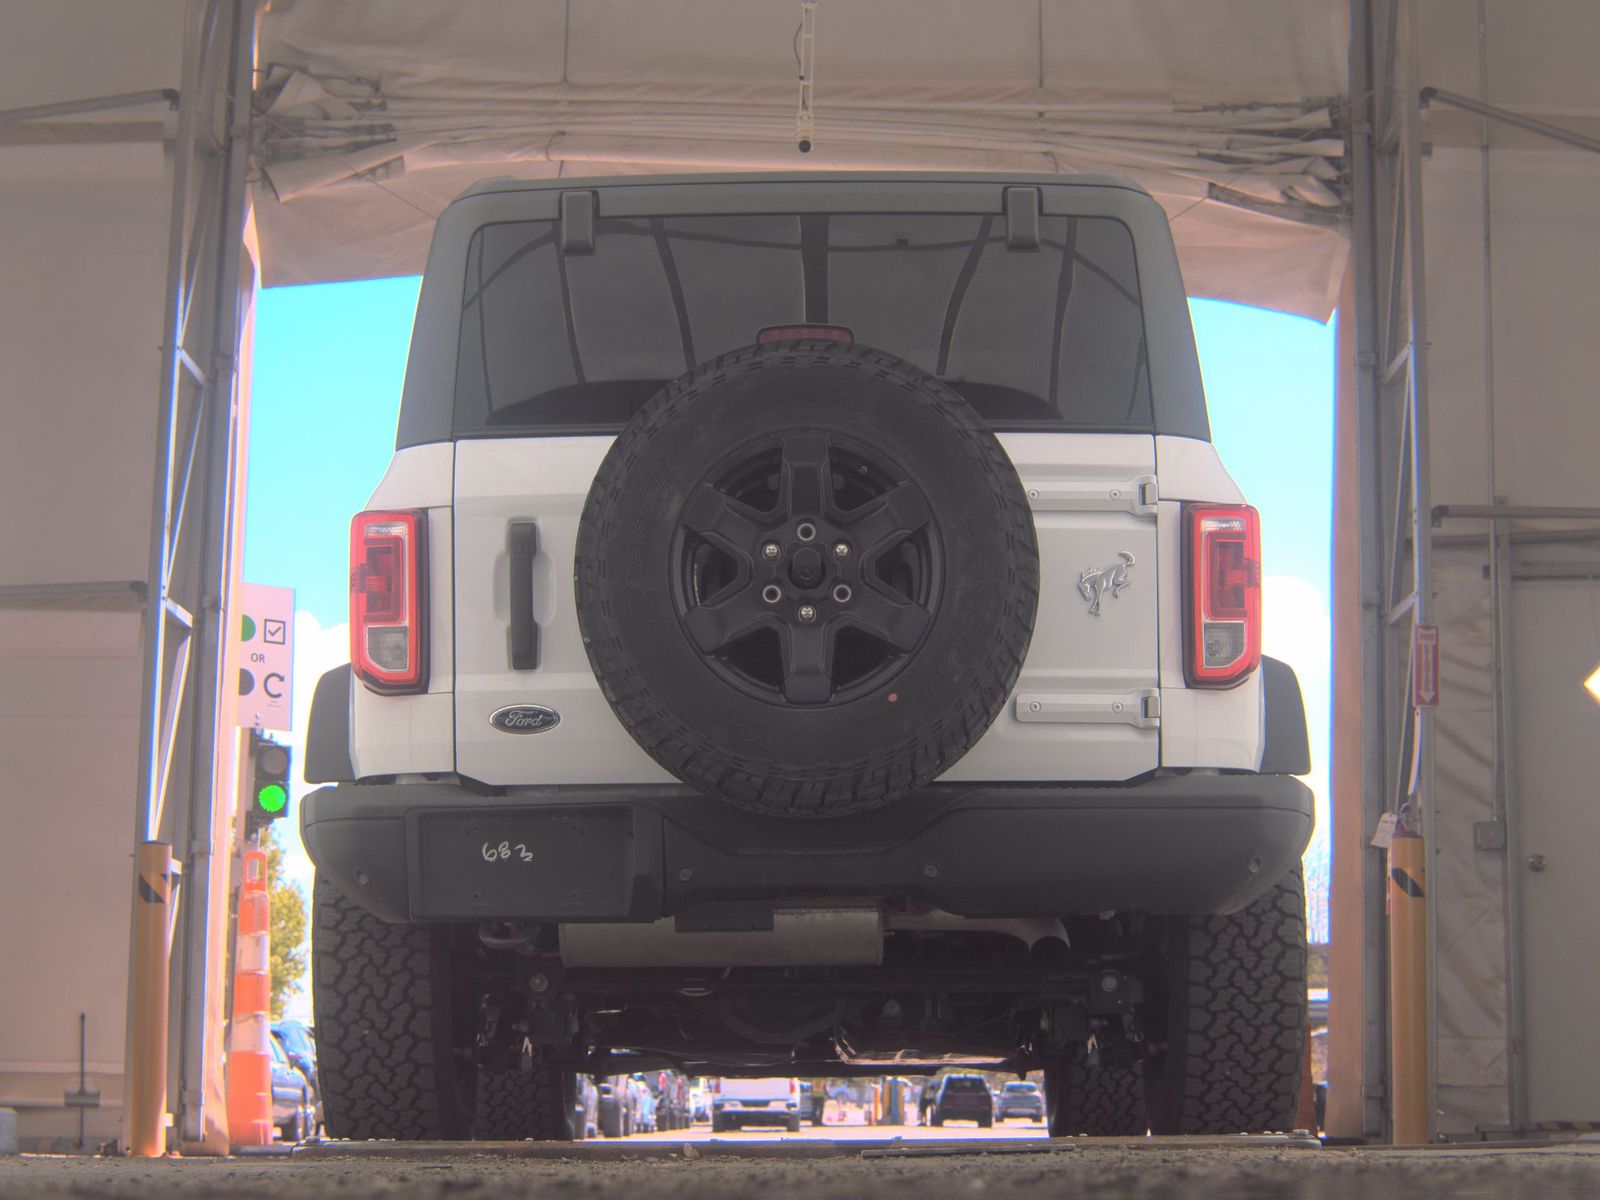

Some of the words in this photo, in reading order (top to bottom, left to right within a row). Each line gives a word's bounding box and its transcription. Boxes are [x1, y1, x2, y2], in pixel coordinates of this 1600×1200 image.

[251, 653, 265, 663] OR
[505, 710, 543, 727] Ford
[482, 840, 533, 863] 683
